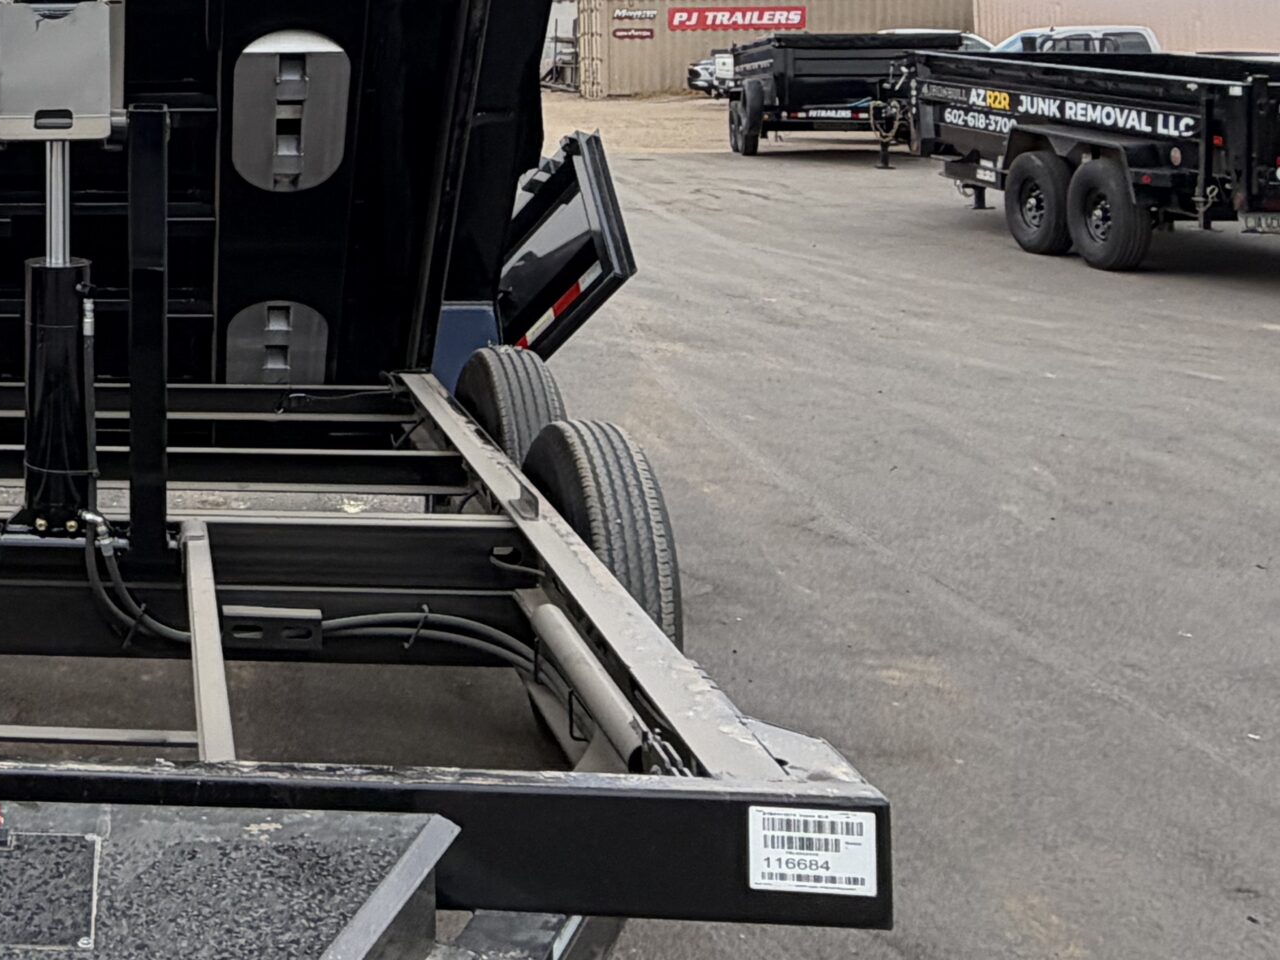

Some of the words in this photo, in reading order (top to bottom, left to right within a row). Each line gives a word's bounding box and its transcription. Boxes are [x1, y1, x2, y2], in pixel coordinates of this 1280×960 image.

[673, 12, 697, 25] PJ
[705, 11, 802, 25] TRAILERS
[1018, 95, 1061, 119] JUNK
[1065, 101, 1152, 133] REMOVAL
[1157, 113, 1195, 137] LLC
[763, 856, 831, 872] 116684
